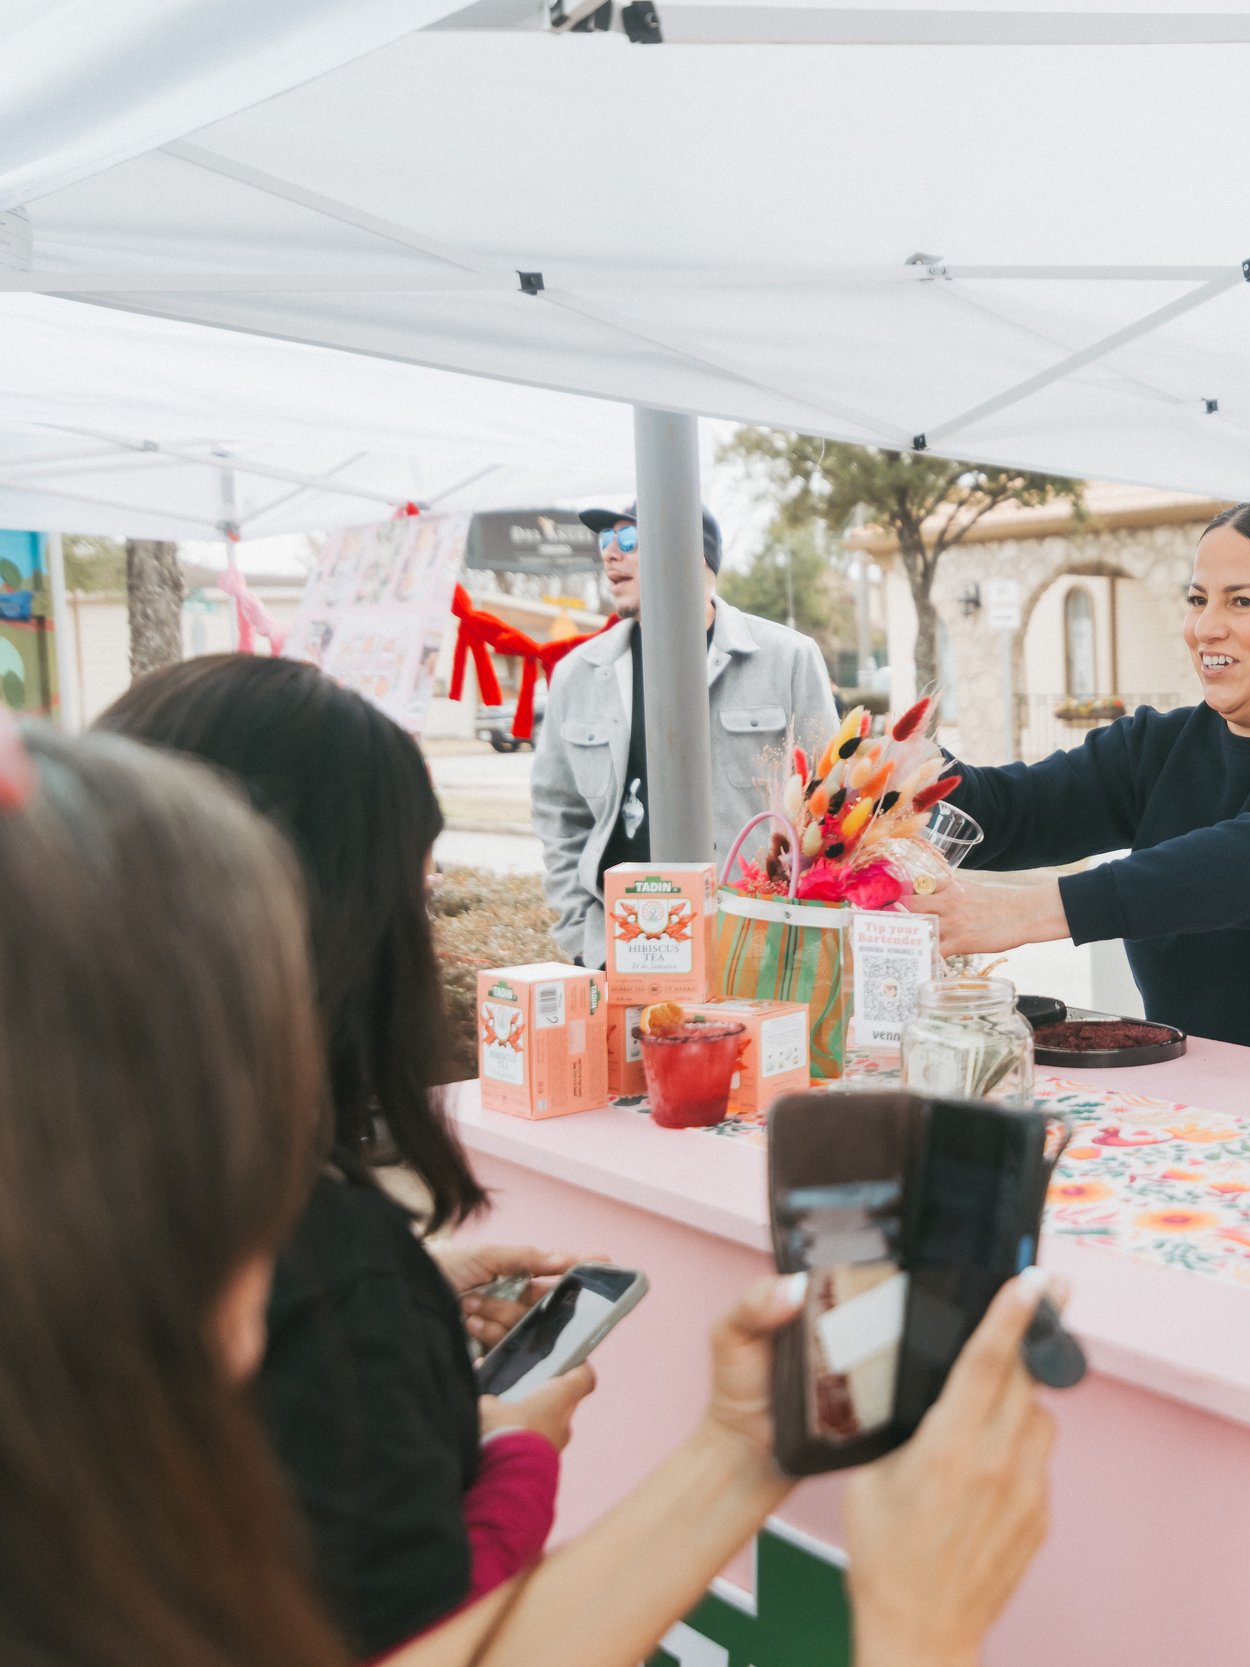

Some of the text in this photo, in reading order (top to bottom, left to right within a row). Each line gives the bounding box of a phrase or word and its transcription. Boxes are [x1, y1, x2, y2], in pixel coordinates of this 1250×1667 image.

[635, 882, 672, 893] TADIN
[864, 922, 920, 935] Tip your
[858, 932, 923, 945] Bartender
[628, 944, 680, 953] HIBISCUS
[644, 952, 665, 961] TEA
[493, 985, 514, 999] TADIN
[590, 985, 598, 1009] TADIN
